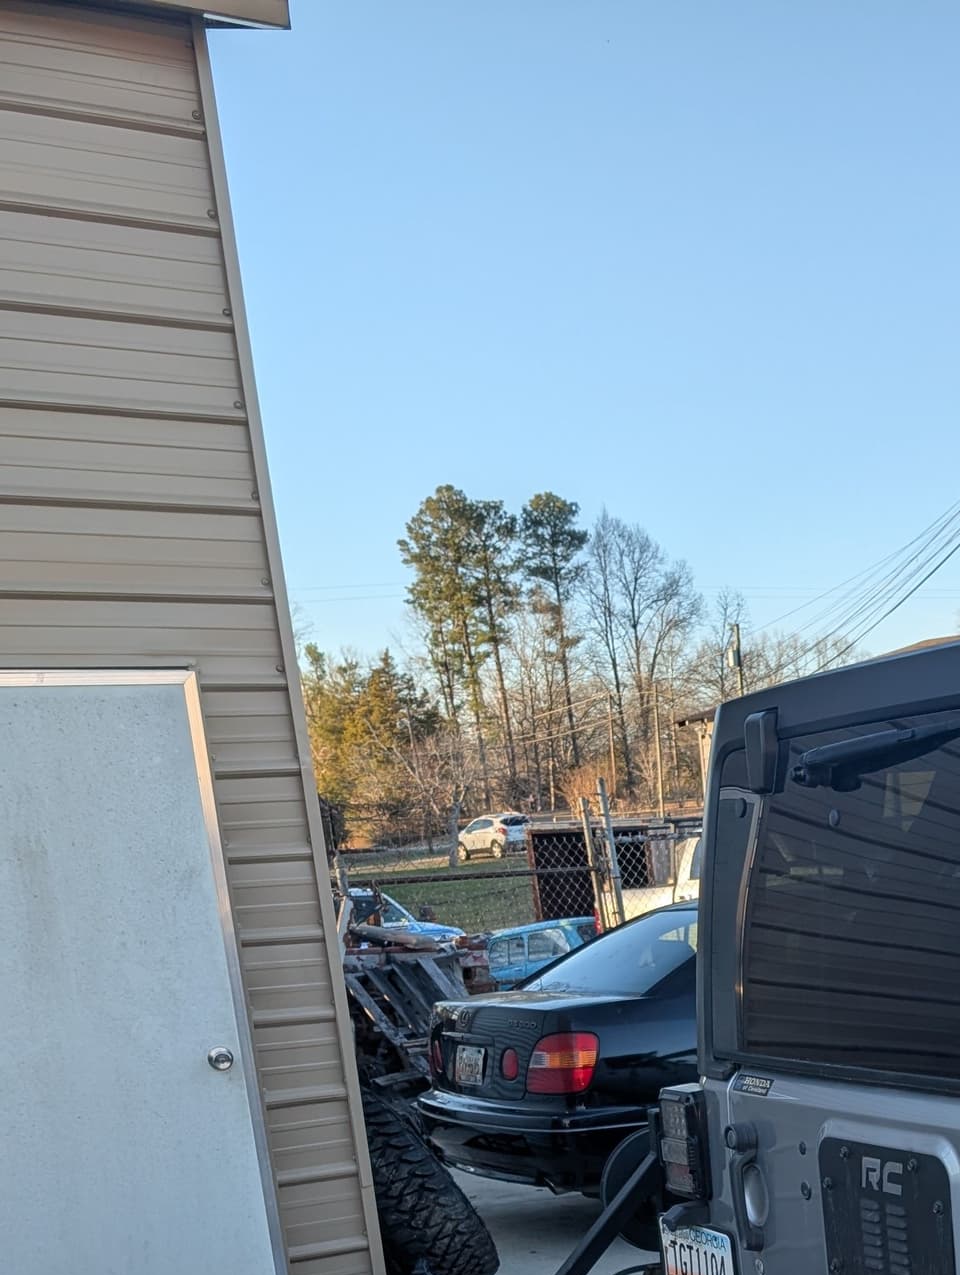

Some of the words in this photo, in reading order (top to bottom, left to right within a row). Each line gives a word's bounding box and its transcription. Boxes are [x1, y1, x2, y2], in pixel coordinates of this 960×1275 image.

[744, 1076, 770, 1088] HONDA
[861, 1155, 903, 1196] RC
[689, 1227, 727, 1252] GEORGIA
